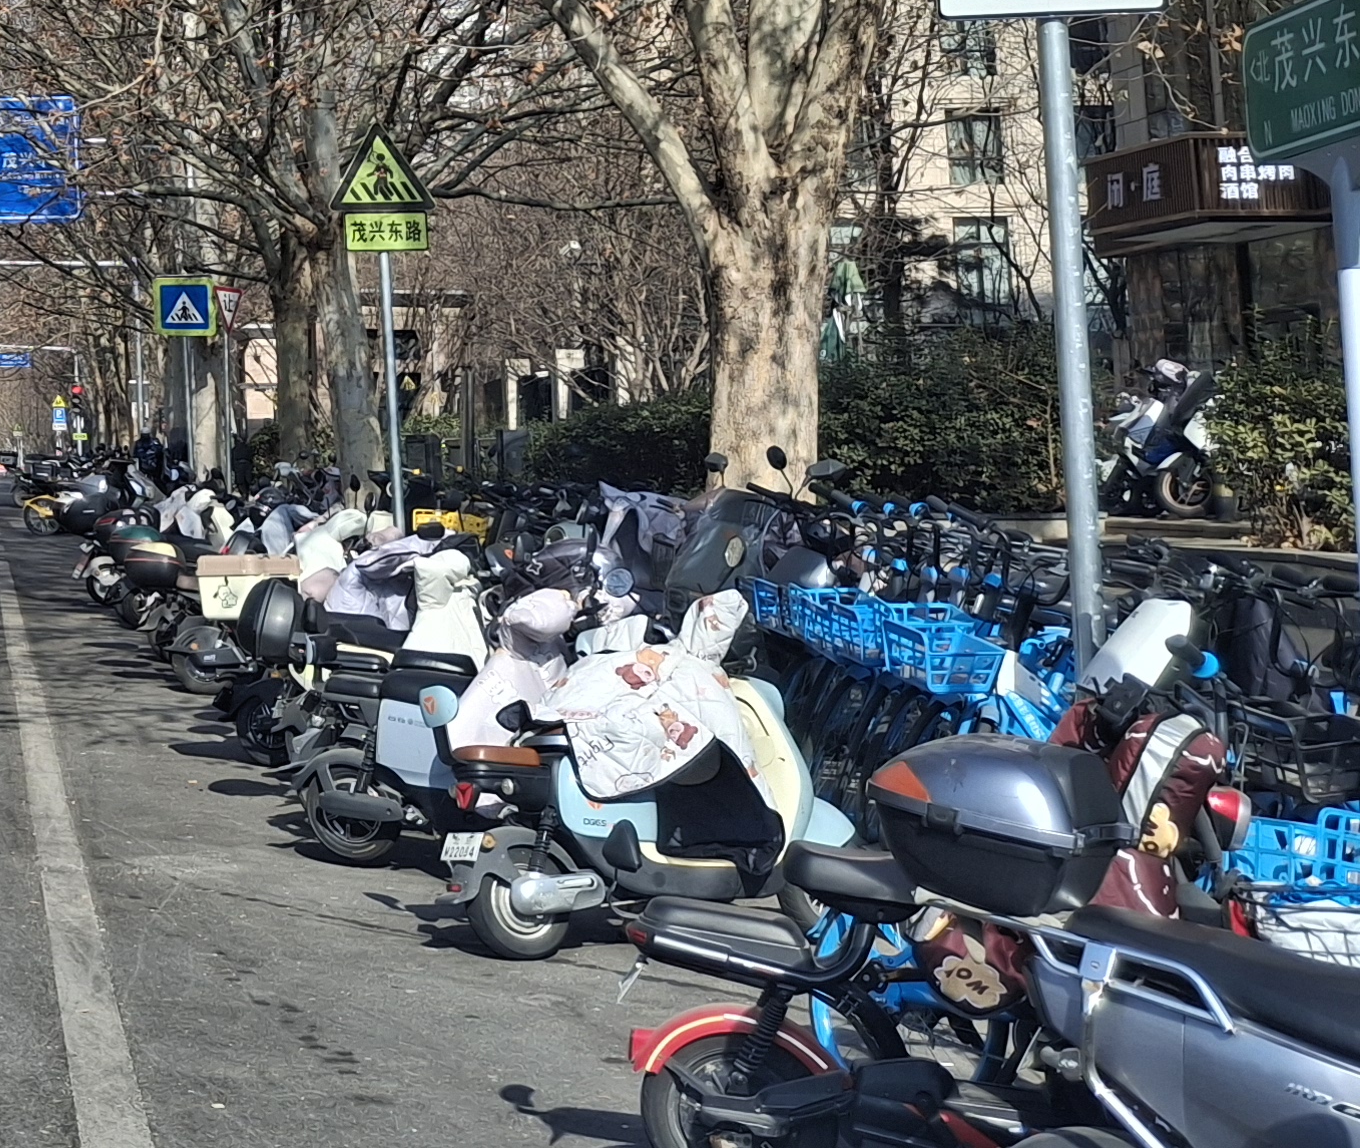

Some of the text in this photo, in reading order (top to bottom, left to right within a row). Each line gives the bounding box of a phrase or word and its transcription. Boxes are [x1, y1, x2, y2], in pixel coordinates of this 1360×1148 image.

[1264, 120, 1273, 146] N
[1290, 96, 1336, 132] MAOXING
[1220, 164, 1295, 181] 肉串烤肉
[1219, 182, 1259, 199] 酒馆
[350, 220, 422, 243] 茂兴东路
